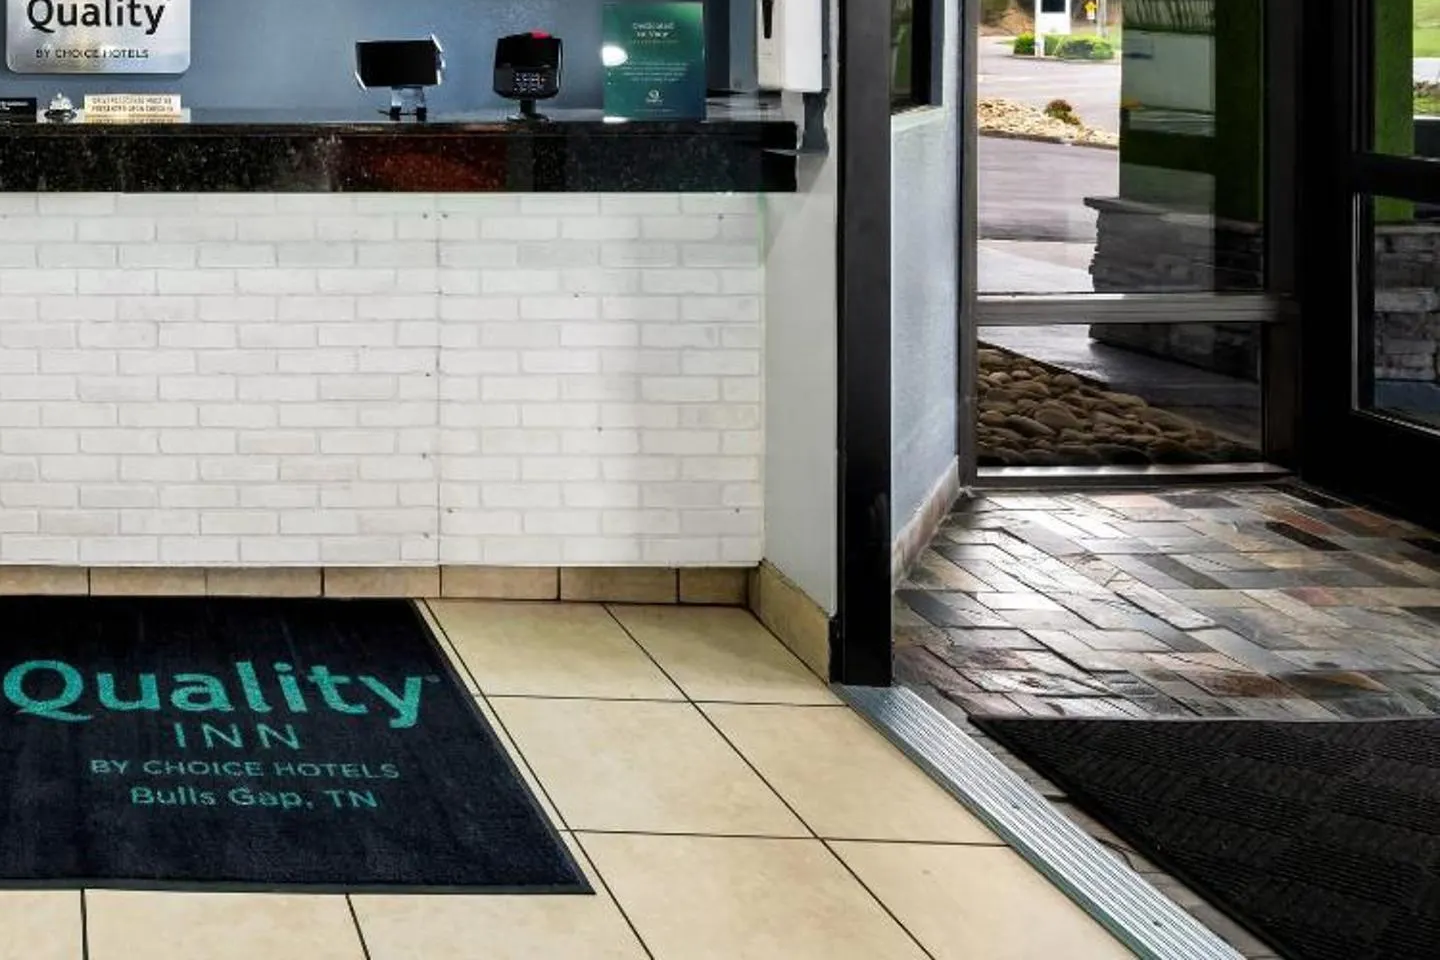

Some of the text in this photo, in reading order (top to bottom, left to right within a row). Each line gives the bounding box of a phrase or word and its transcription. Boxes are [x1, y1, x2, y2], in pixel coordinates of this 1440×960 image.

[36, 49, 150, 59] BY CHOICE HOTELS
[3, 659, 424, 729] Quality
[172, 722, 303, 750] INN
[90, 759, 401, 780] BY CHOICE HOTELS
[130, 786, 215, 807] Bulls
[323, 788, 379, 809] TN
